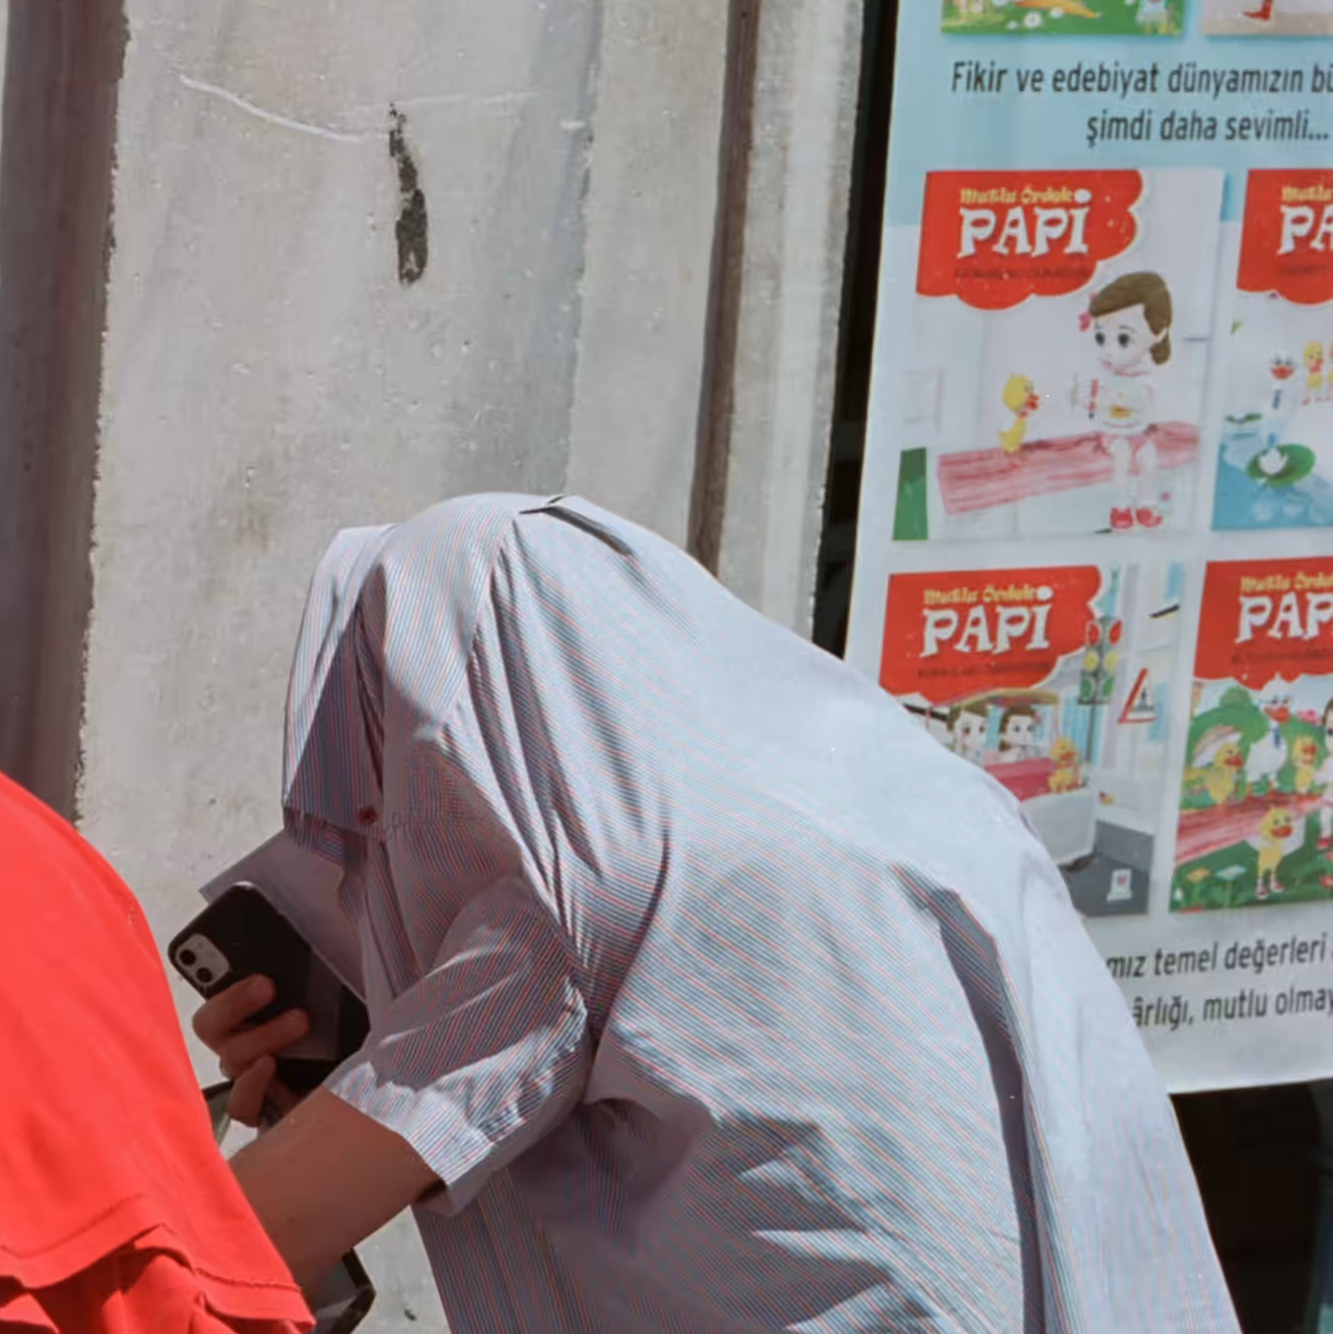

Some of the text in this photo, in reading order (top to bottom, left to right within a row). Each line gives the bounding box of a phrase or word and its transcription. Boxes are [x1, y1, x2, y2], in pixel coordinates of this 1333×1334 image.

[951, 60, 1007, 93] Fikir
[1016, 69, 1043, 93] ve
[1052, 61, 1159, 99] edebiyat
[1167, 61, 1304, 100] dünyamızın
[1086, 107, 1331, 148] şimdi daha sevimli...
[1275, 203, 1333, 257] PA
[1234, 589, 1333, 644] PAP
[1106, 955, 1147, 980] mız
[1153, 941, 1220, 977] temel
[1223, 930, 1329, 975] değerleri
[1132, 995, 1195, 1032] ârlığı,
[1202, 988, 1269, 1021] mutlu
